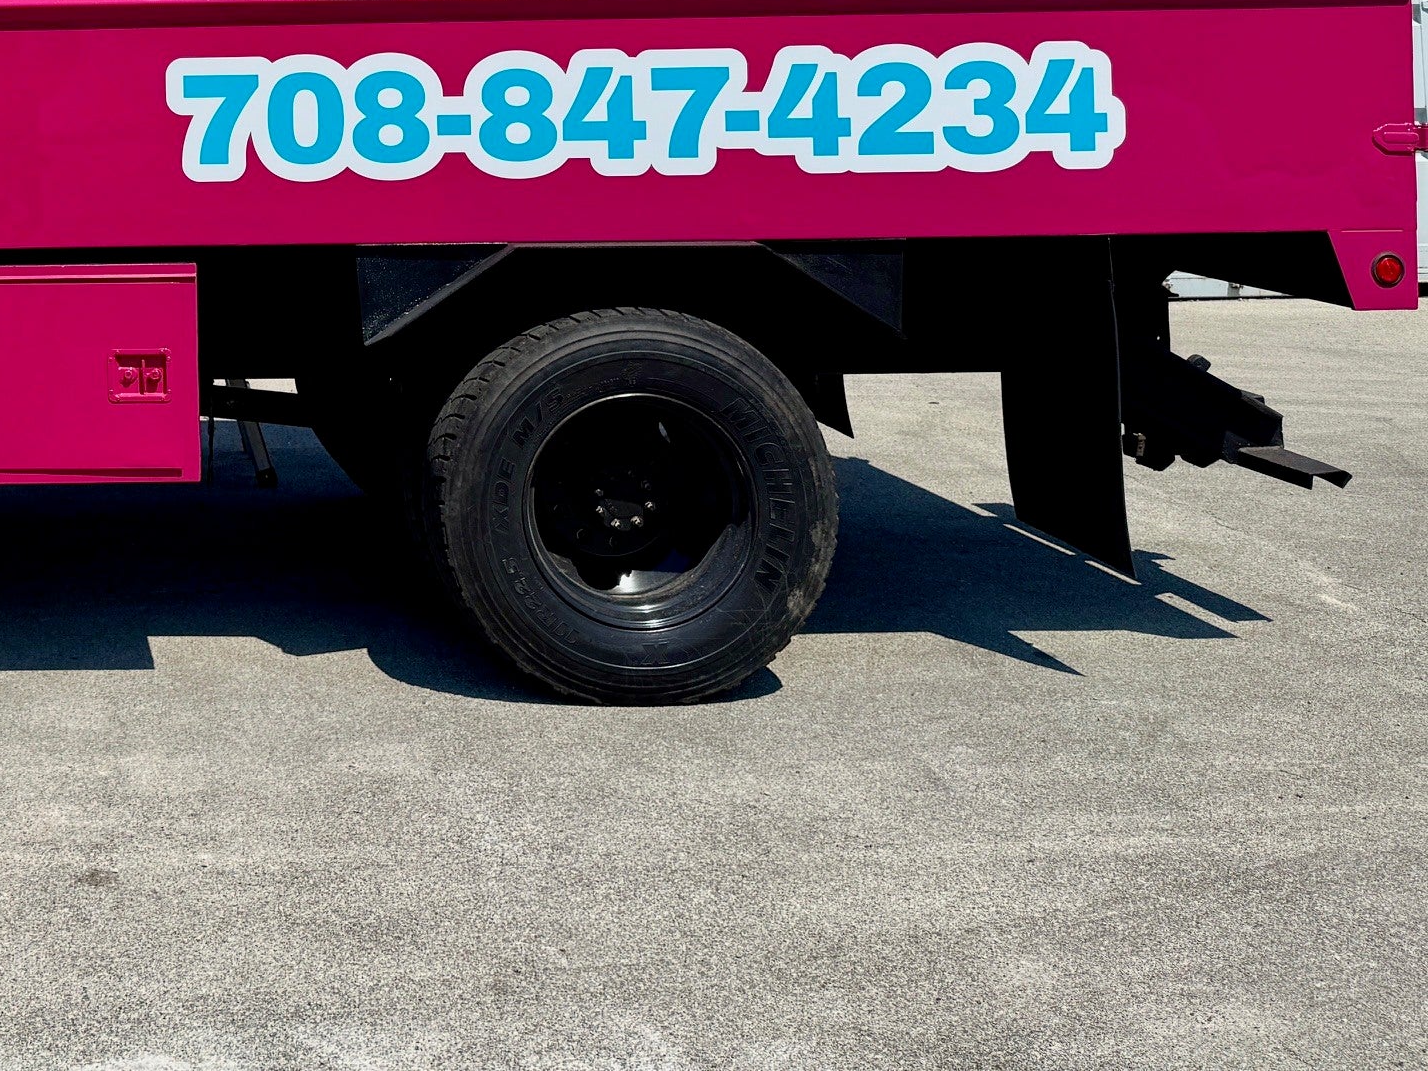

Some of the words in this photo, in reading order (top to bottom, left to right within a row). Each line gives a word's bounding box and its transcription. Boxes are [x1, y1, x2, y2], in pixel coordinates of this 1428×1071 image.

[181, 57, 1108, 166] 708-847-4234
[491, 457, 516, 534] XDE
[511, 385, 565, 450] M/S
[720, 397, 796, 596] MICHELIN
